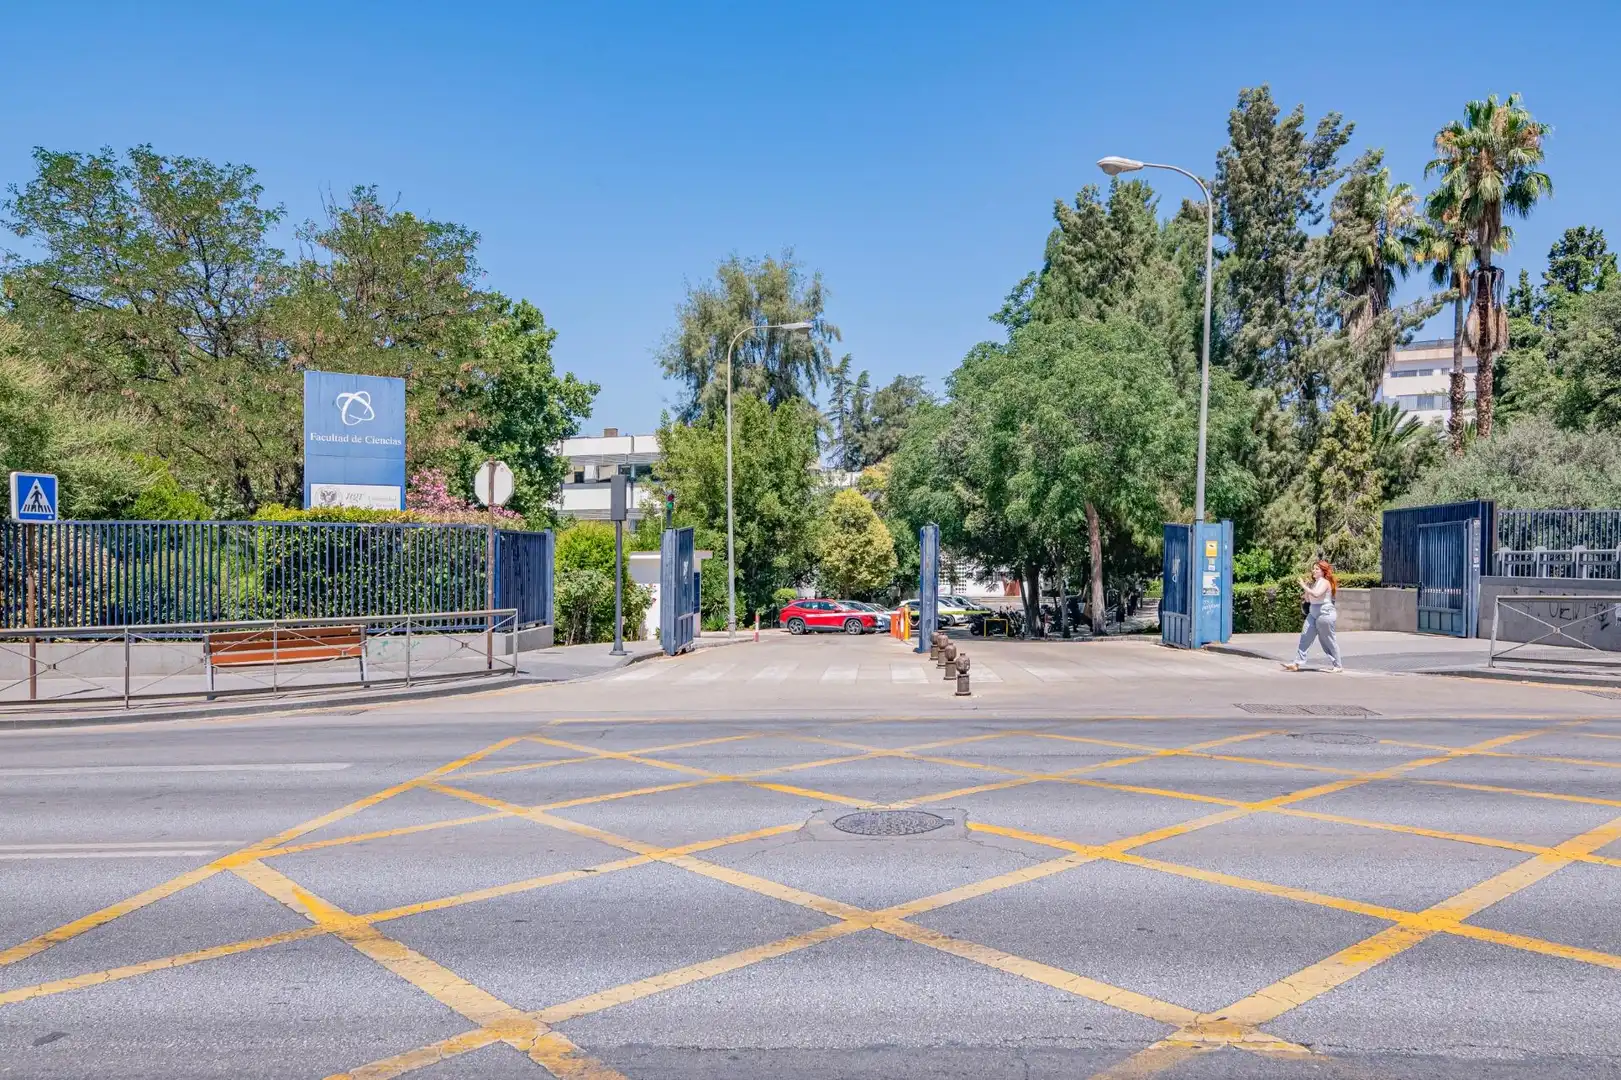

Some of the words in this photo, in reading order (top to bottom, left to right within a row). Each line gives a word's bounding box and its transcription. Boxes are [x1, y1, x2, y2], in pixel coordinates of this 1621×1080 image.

[310, 432, 349, 443] Facultad
[351, 434, 362, 443] de
[364, 435, 402, 446] Ciencias
